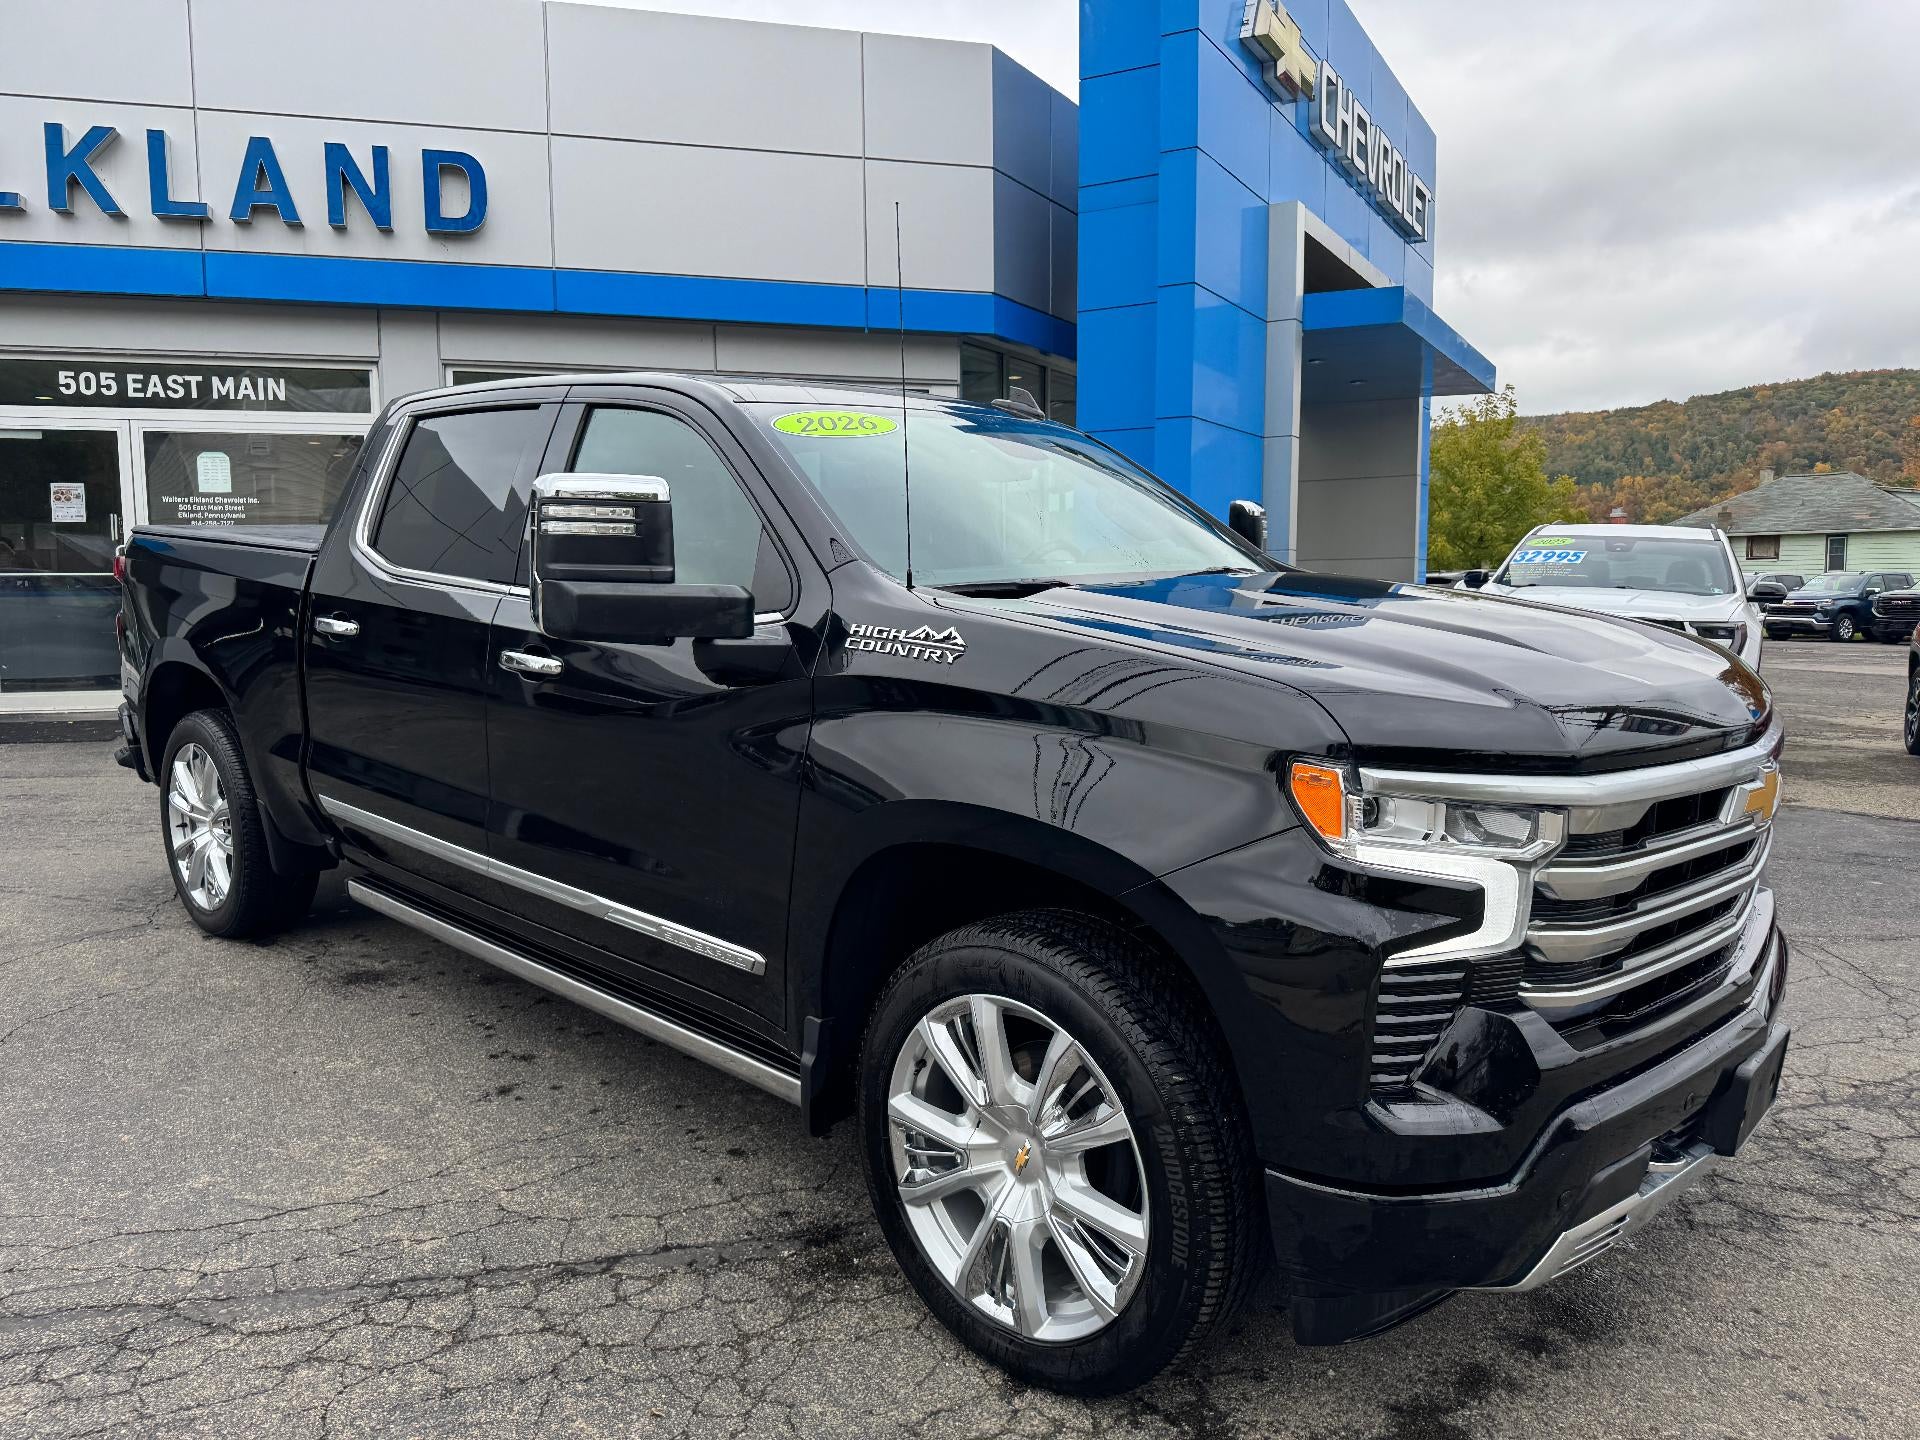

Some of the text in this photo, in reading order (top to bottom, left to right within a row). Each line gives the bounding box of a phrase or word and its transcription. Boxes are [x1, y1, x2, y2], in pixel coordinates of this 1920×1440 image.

[1317, 58, 1432, 243] CHEVROLET
[0, 121, 489, 236] KLAND
[58, 370, 287, 401] 505 EAST MAIN
[796, 416, 878, 432] 2026
[204, 512, 246, 520] Pennsylvania
[1513, 550, 1585, 563] 32995
[849, 623, 908, 641] HIGH
[844, 638, 965, 664] COUNTRY
[1153, 1124, 1191, 1272] BRIDGESTONE
